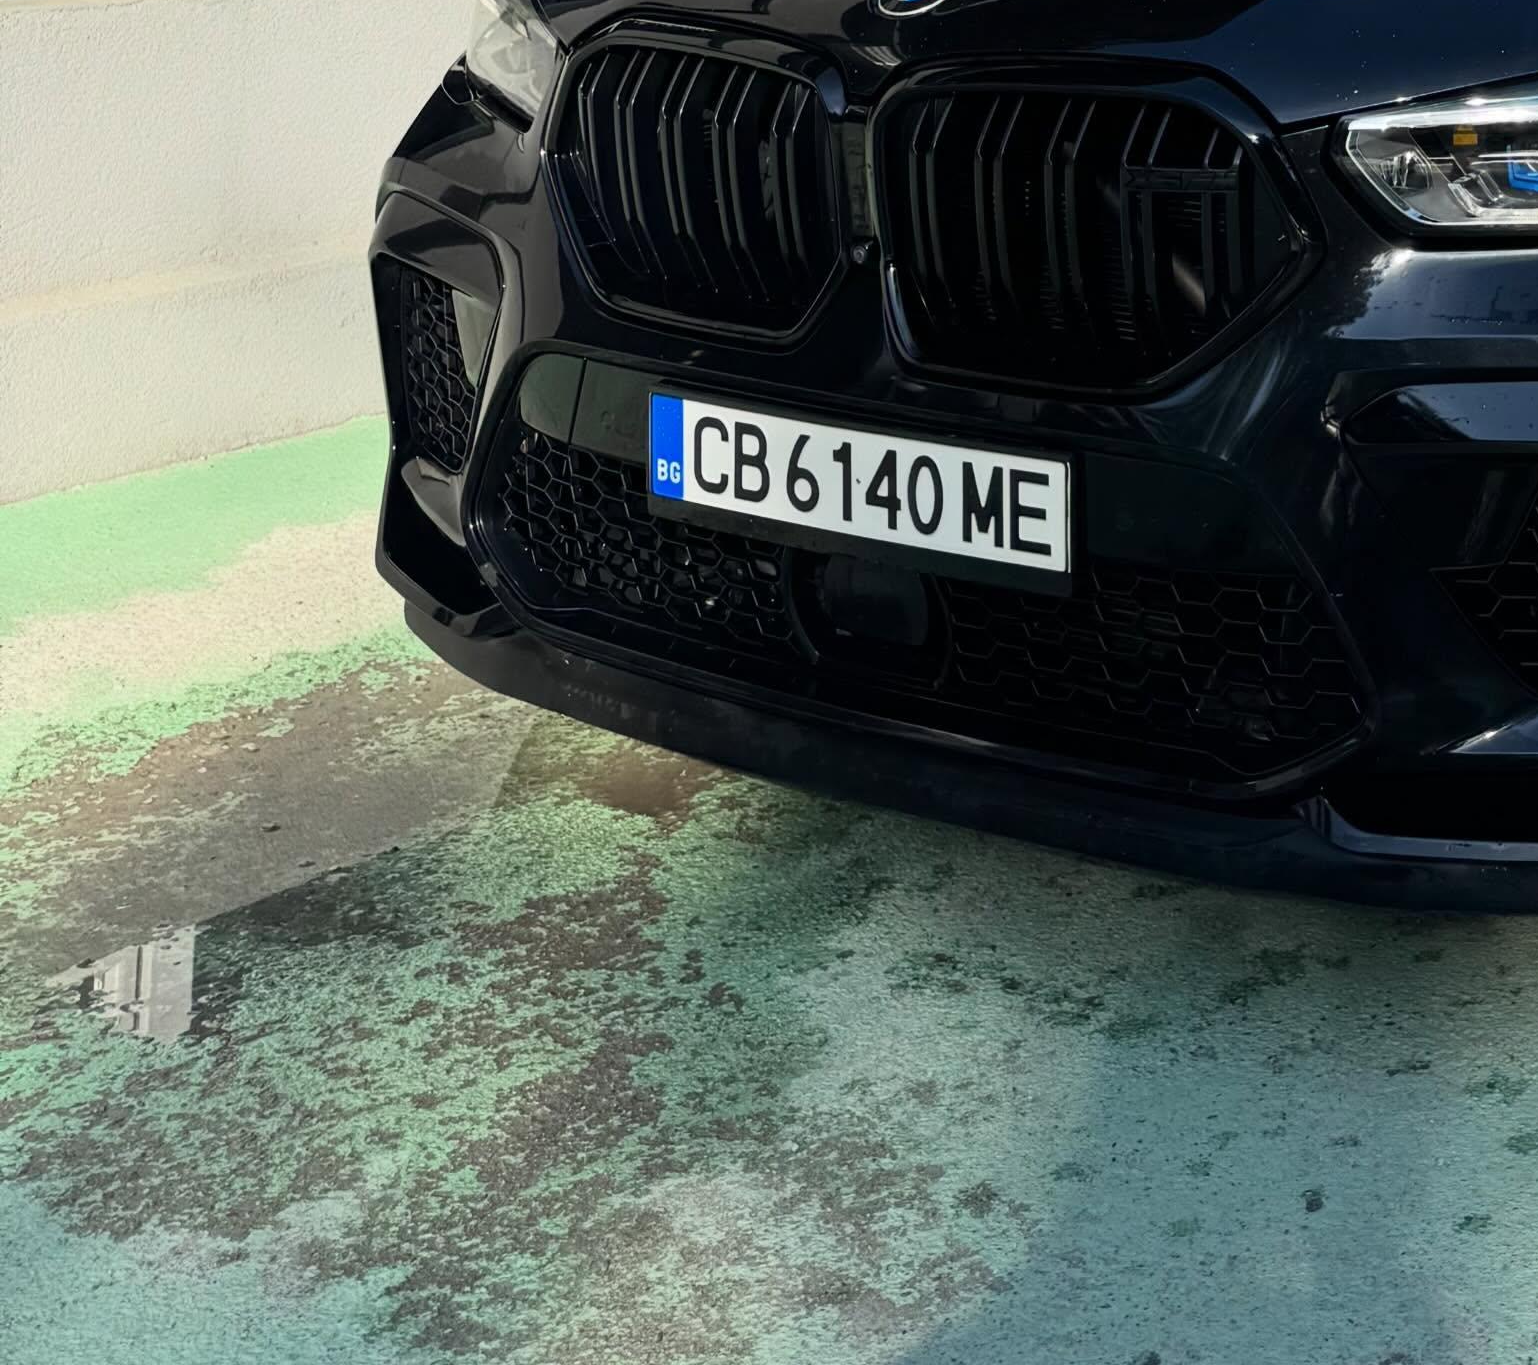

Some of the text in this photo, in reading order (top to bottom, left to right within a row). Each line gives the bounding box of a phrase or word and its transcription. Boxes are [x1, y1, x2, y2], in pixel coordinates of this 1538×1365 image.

[657, 458, 681, 484] BG
[693, 416, 1052, 557] CB 6140 ME
